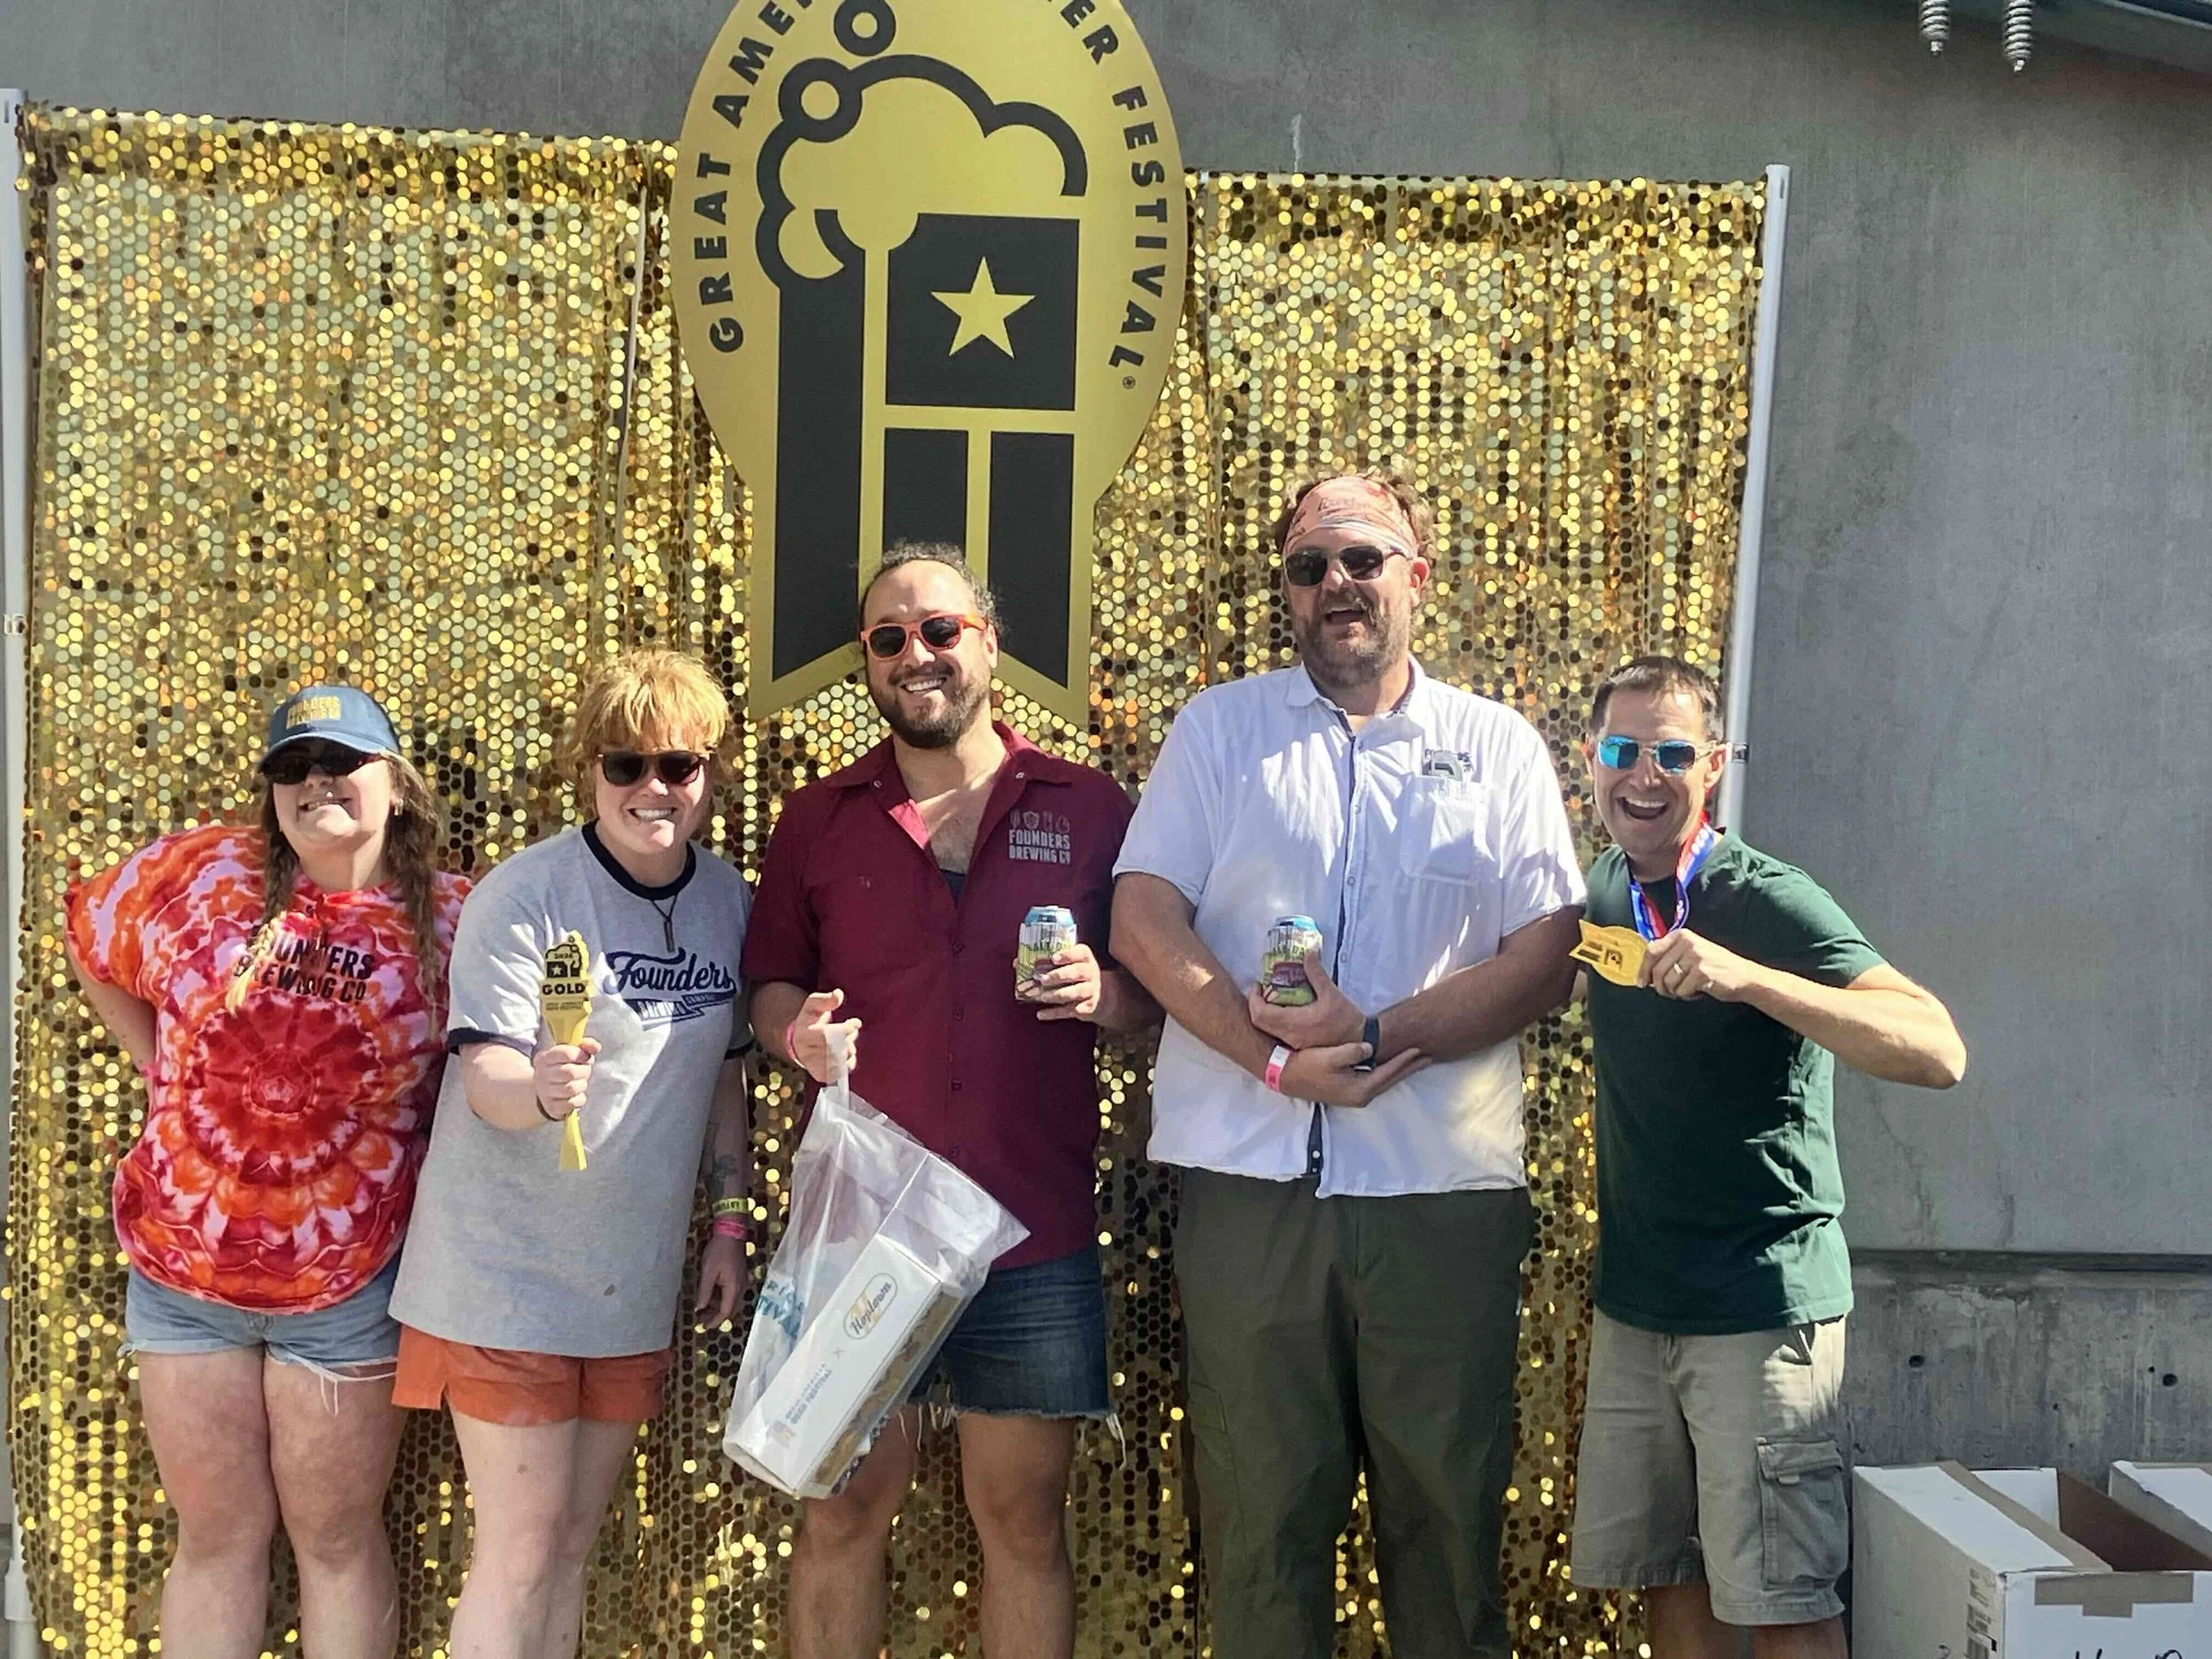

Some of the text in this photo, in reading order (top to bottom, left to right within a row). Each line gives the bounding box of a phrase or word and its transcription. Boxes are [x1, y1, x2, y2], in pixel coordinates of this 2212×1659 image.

[695, 0, 1168, 368] GREAT AME ER FESTIVAL
[1009, 829, 1071, 850] FOUNDERS
[1009, 844, 1058, 864] BREWING
[603, 947, 738, 995] Founders
[541, 983, 586, 995] GOLD
